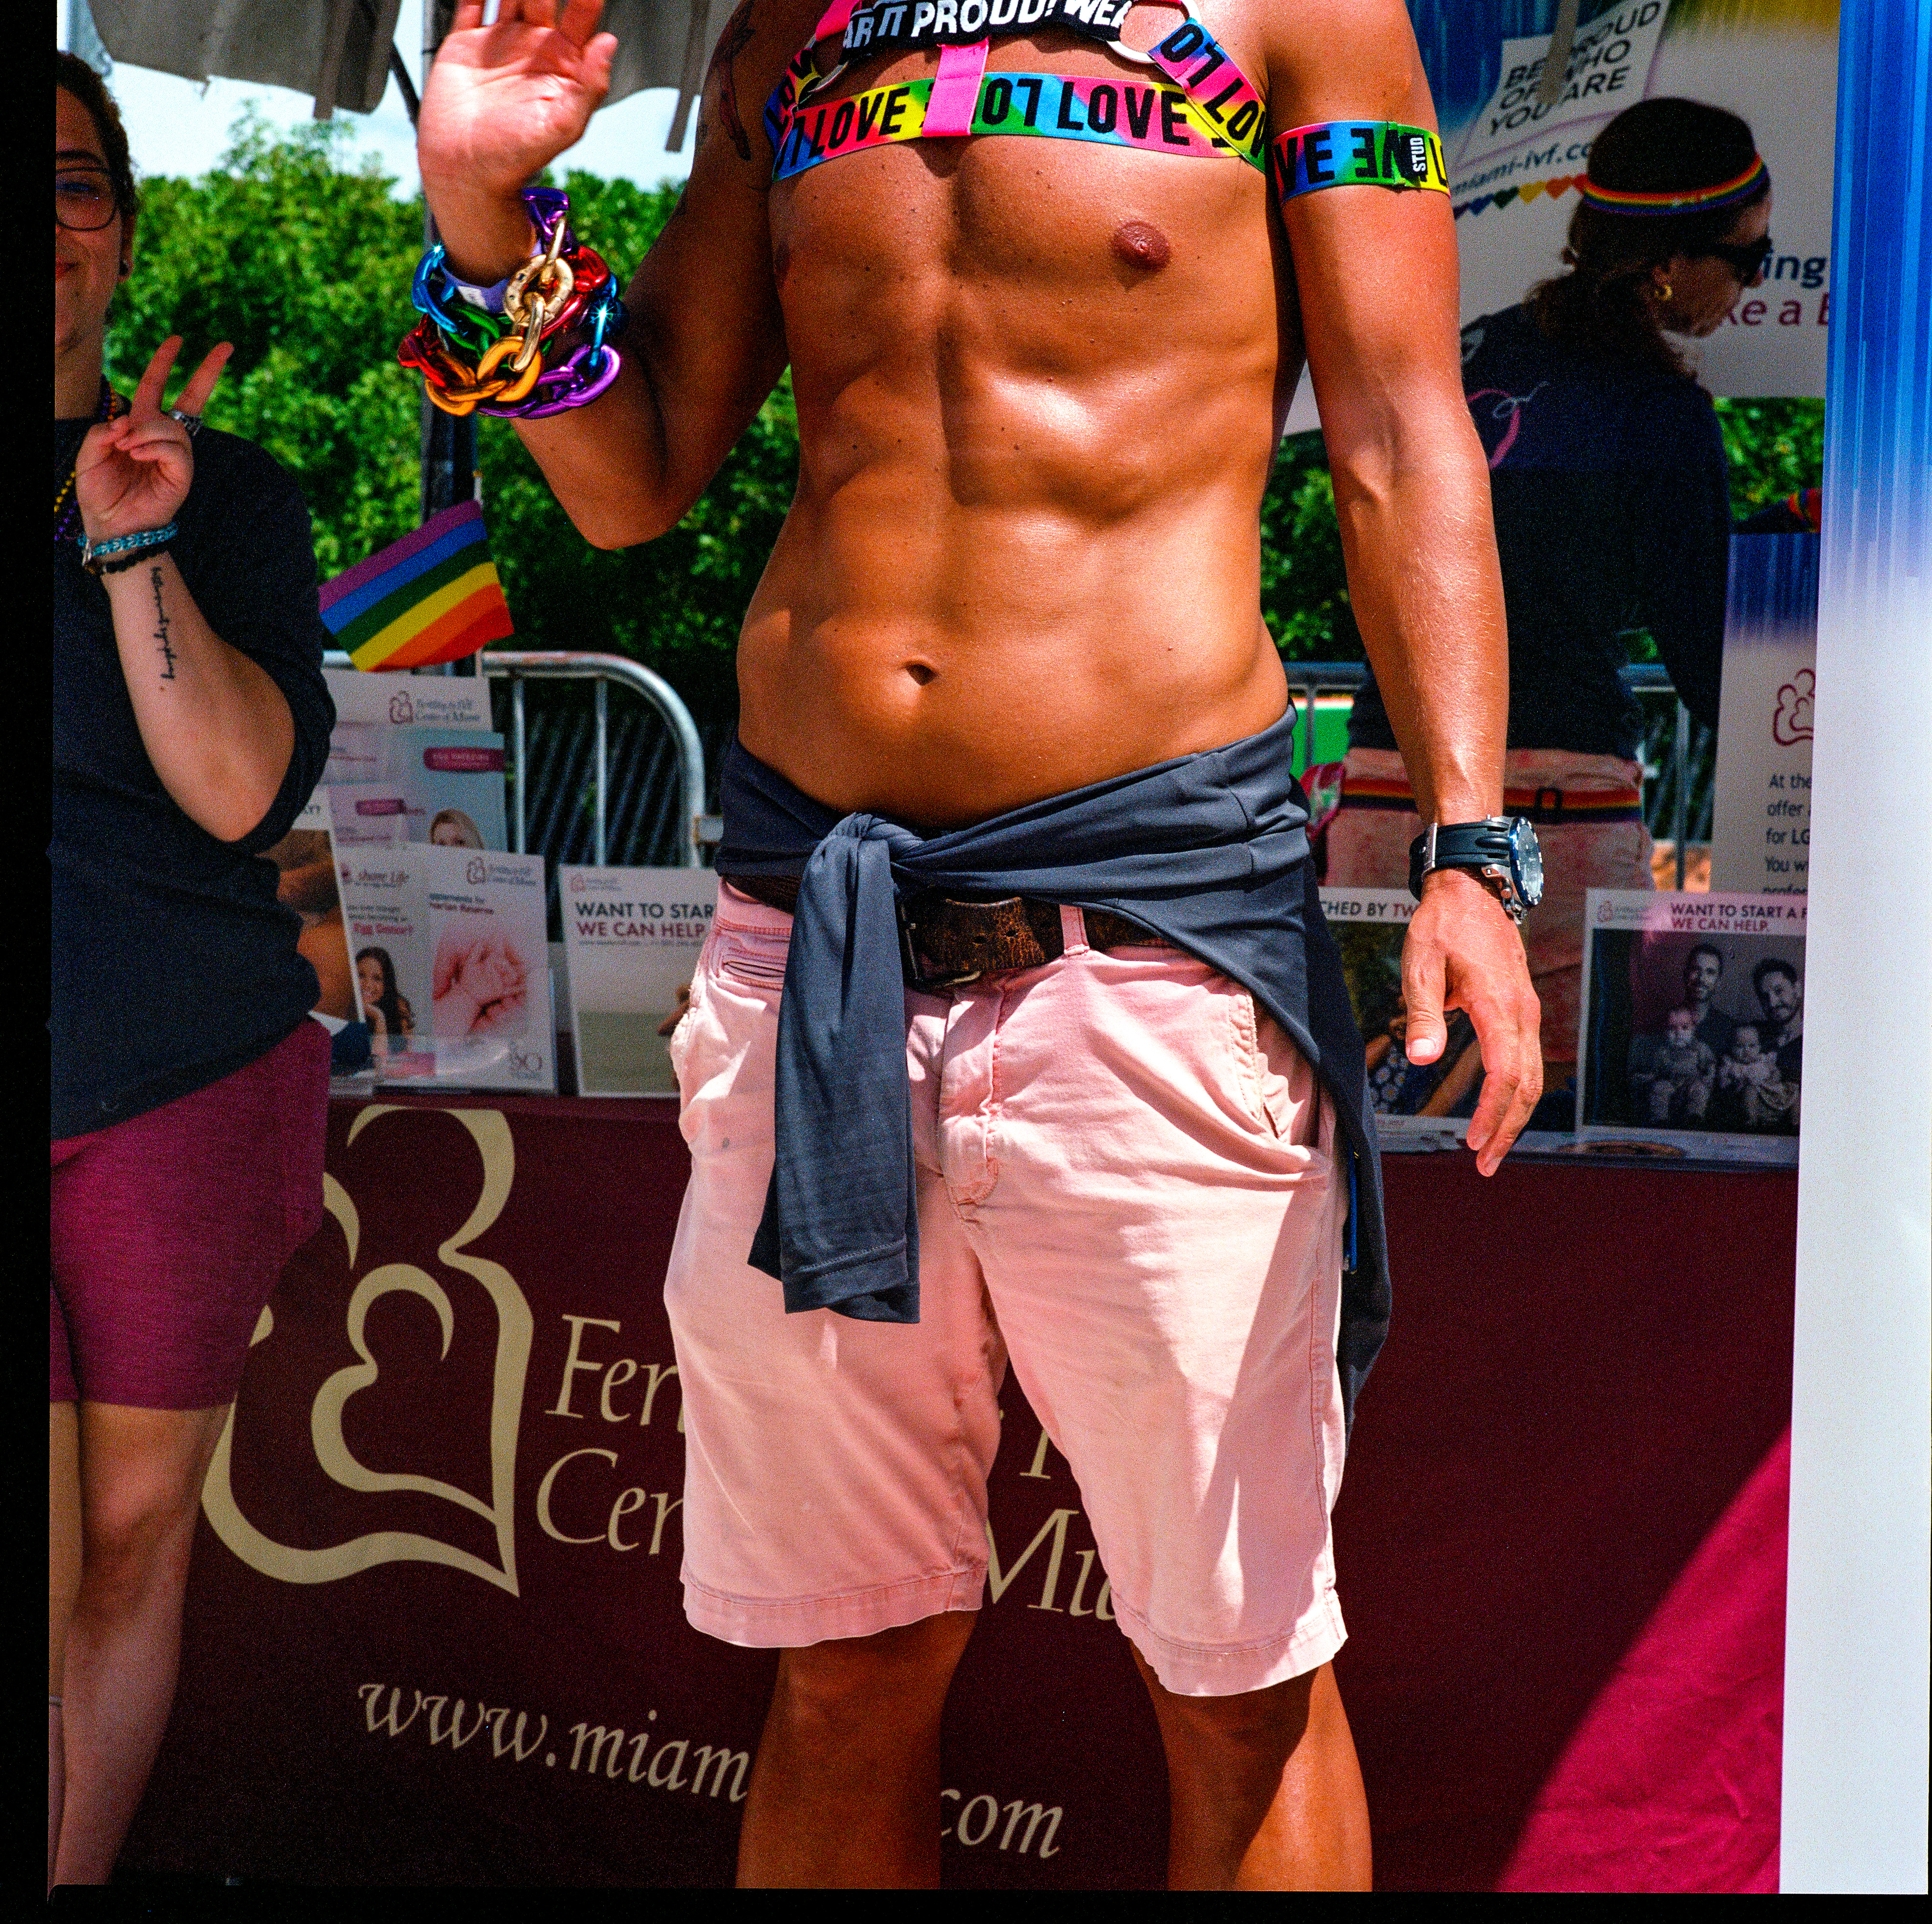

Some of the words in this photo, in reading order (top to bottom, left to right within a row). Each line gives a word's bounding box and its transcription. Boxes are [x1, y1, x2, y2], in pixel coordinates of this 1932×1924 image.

[877, 5, 908, 37] IT
[911, 0, 1055, 37] PROUD!
[1491, 102, 1553, 136] YOU
[1559, 66, 1631, 107] ARE
[808, 87, 910, 159] LOVE
[1056, 82, 1191, 146] LOVE
[1409, 137, 1426, 173] STUD
[1769, 773, 1784, 789] At
[1767, 799, 1804, 817] offer
[1765, 827, 1788, 845] for
[1765, 856, 1790, 873] You
[575, 901, 634, 917] WANT
[639, 902, 665, 919] TO
[670, 903, 716, 919] STAR
[1321, 901, 1362, 916] HED
[1366, 902, 1388, 917] BY
[1671, 902, 1715, 917] WANT
[1718, 904, 1737, 918] TO
[1741, 905, 1783, 919] START
[1786, 906, 1797, 920] A
[576, 921, 608, 936] WE
[612, 921, 655, 937] CAN
[661, 922, 706, 938] HELP
[1671, 918, 1693, 930] WE
[1697, 918, 1730, 931] CAN
[545, 1314, 685, 1433] Fer
